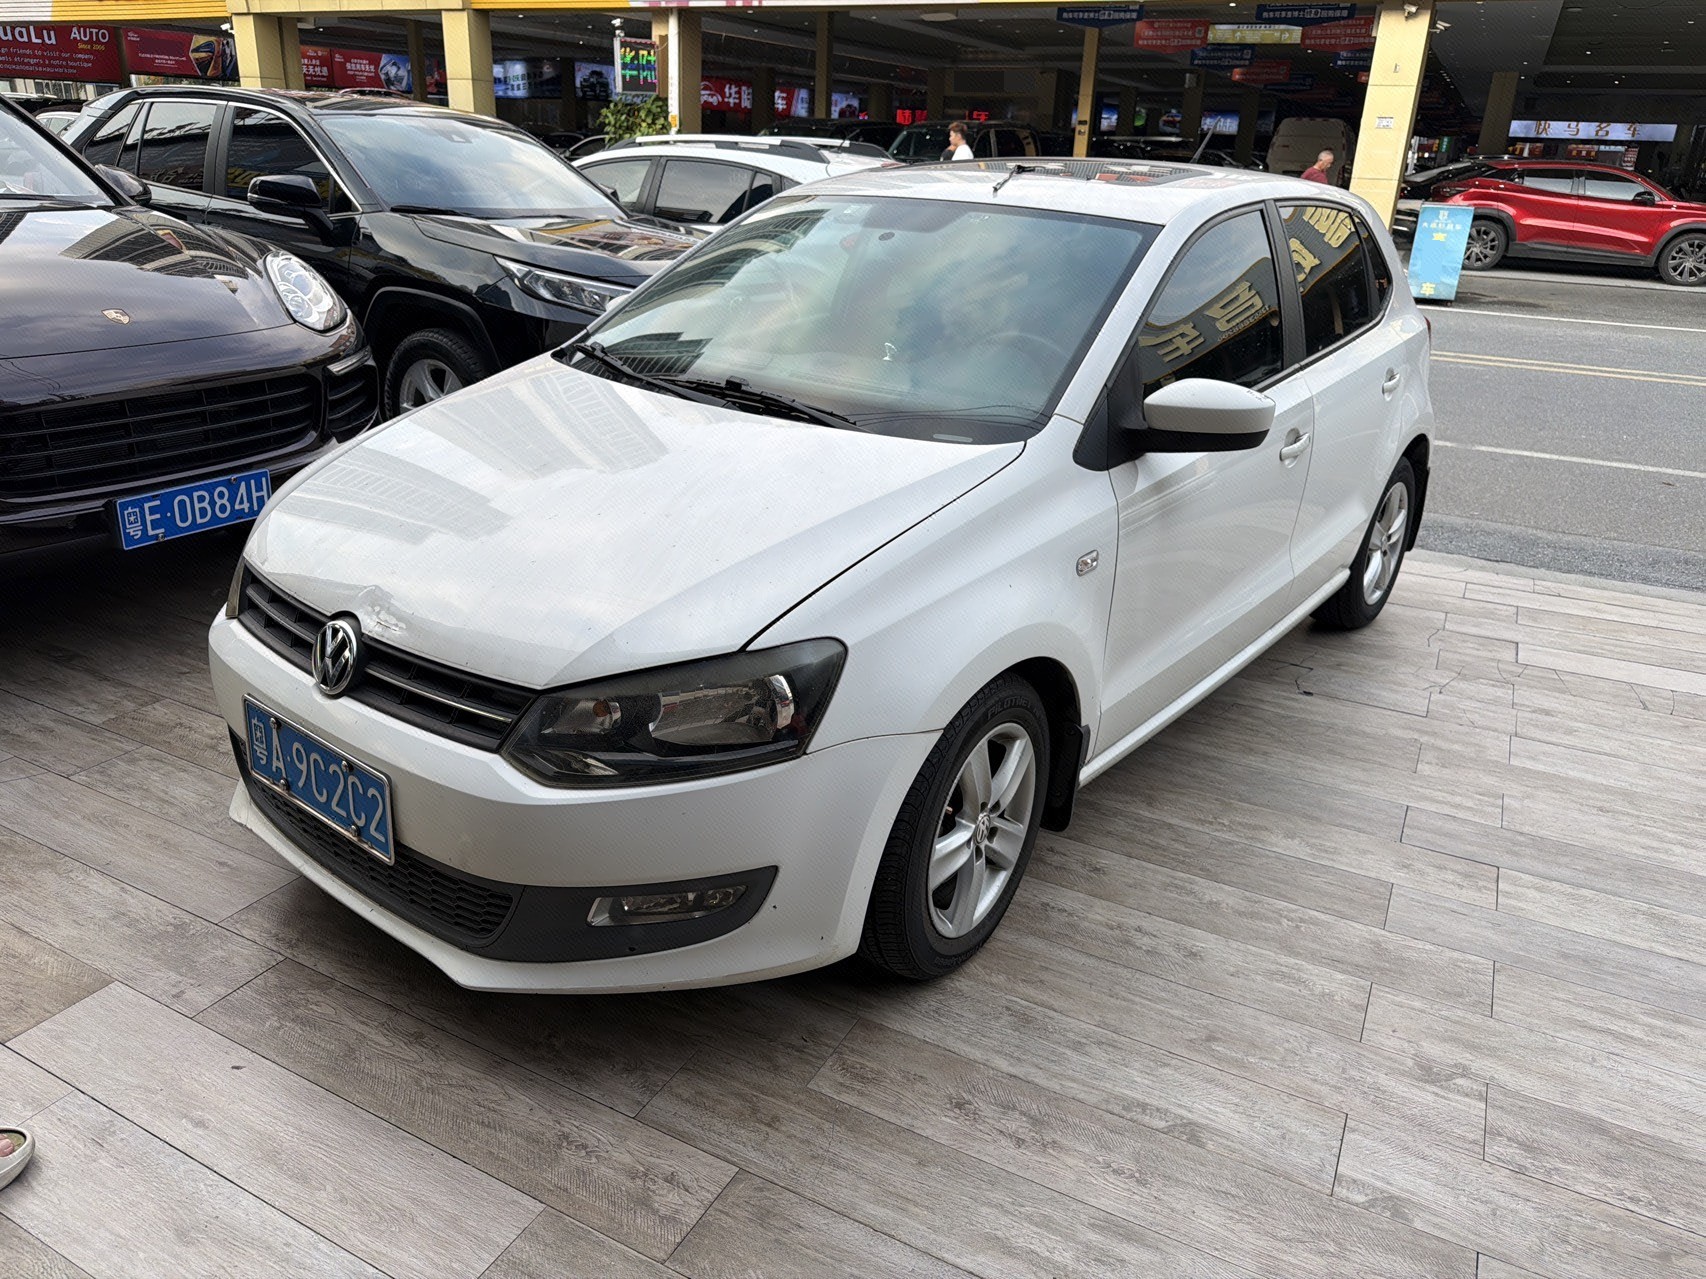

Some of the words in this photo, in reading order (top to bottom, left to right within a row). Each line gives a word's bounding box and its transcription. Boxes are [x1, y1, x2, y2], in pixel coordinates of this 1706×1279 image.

[70, 26, 109, 43] AUTO
[10, 47, 33, 55] friends
[67, 60, 93, 68] boutique
